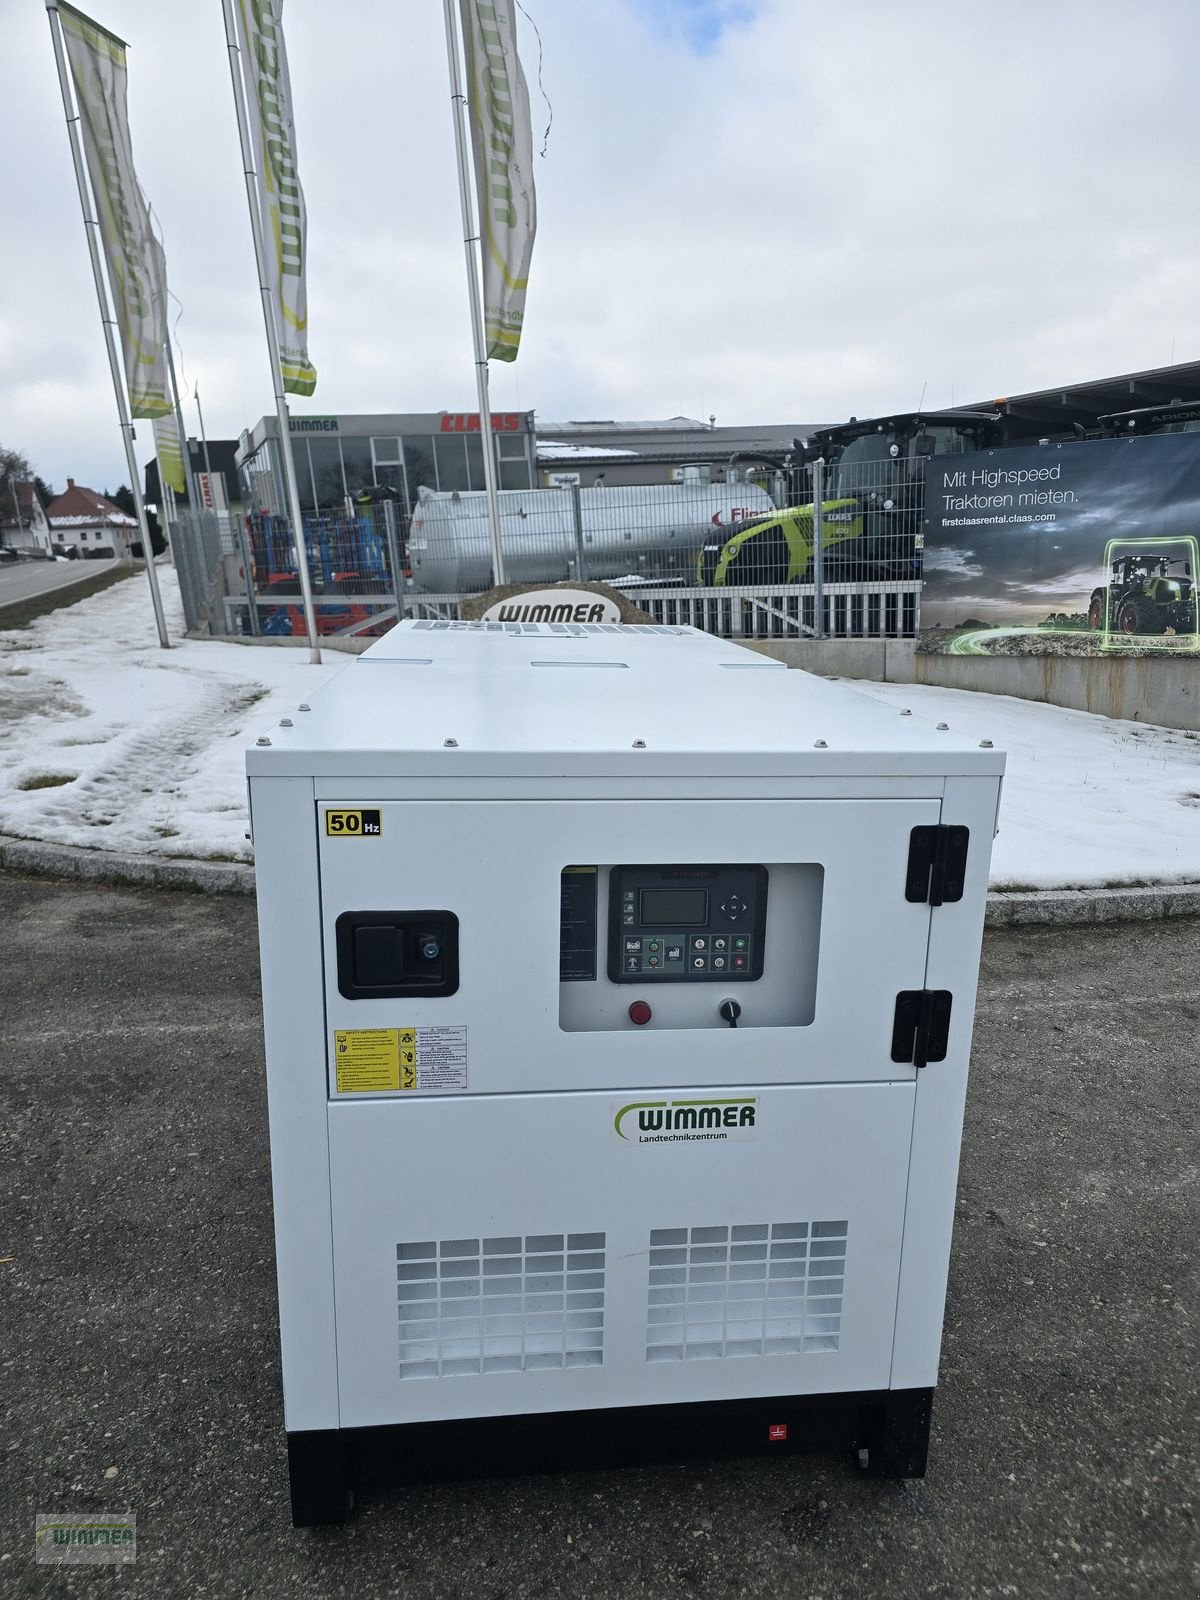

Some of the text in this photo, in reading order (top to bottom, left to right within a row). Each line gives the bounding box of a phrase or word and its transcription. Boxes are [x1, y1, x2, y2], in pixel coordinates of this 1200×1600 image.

[441, 415, 519, 432] CLAAS
[943, 464, 1061, 488] Mit Highspeed
[942, 489, 1079, 510] Traktoren mieten.
[942, 513, 1056, 526] firstclaasrental.claas.com
[498, 604, 605, 622] WIMMER
[330, 814, 380, 833] 50 Hz
[639, 1106, 755, 1131] WIMMER
[639, 1133, 727, 1143] Landtechnikzentrum
